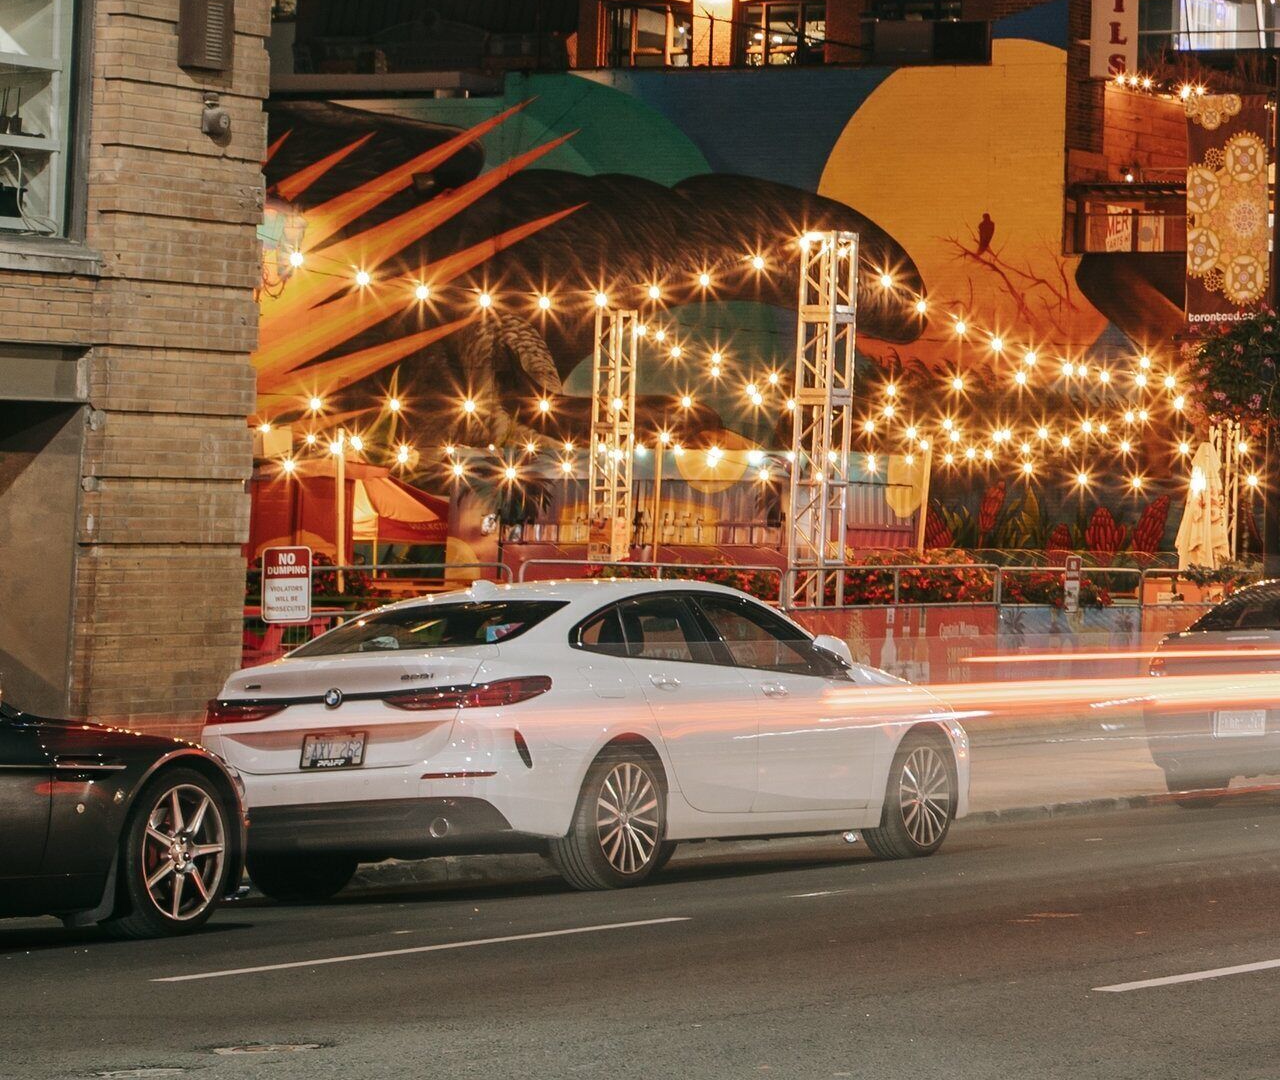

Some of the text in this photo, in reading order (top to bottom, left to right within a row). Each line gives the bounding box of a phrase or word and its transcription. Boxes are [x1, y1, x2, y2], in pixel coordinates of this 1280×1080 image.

[278, 552, 296, 565] NO
[267, 565, 307, 575] DUMPING
[270, 585, 304, 593] VIOLATORS
